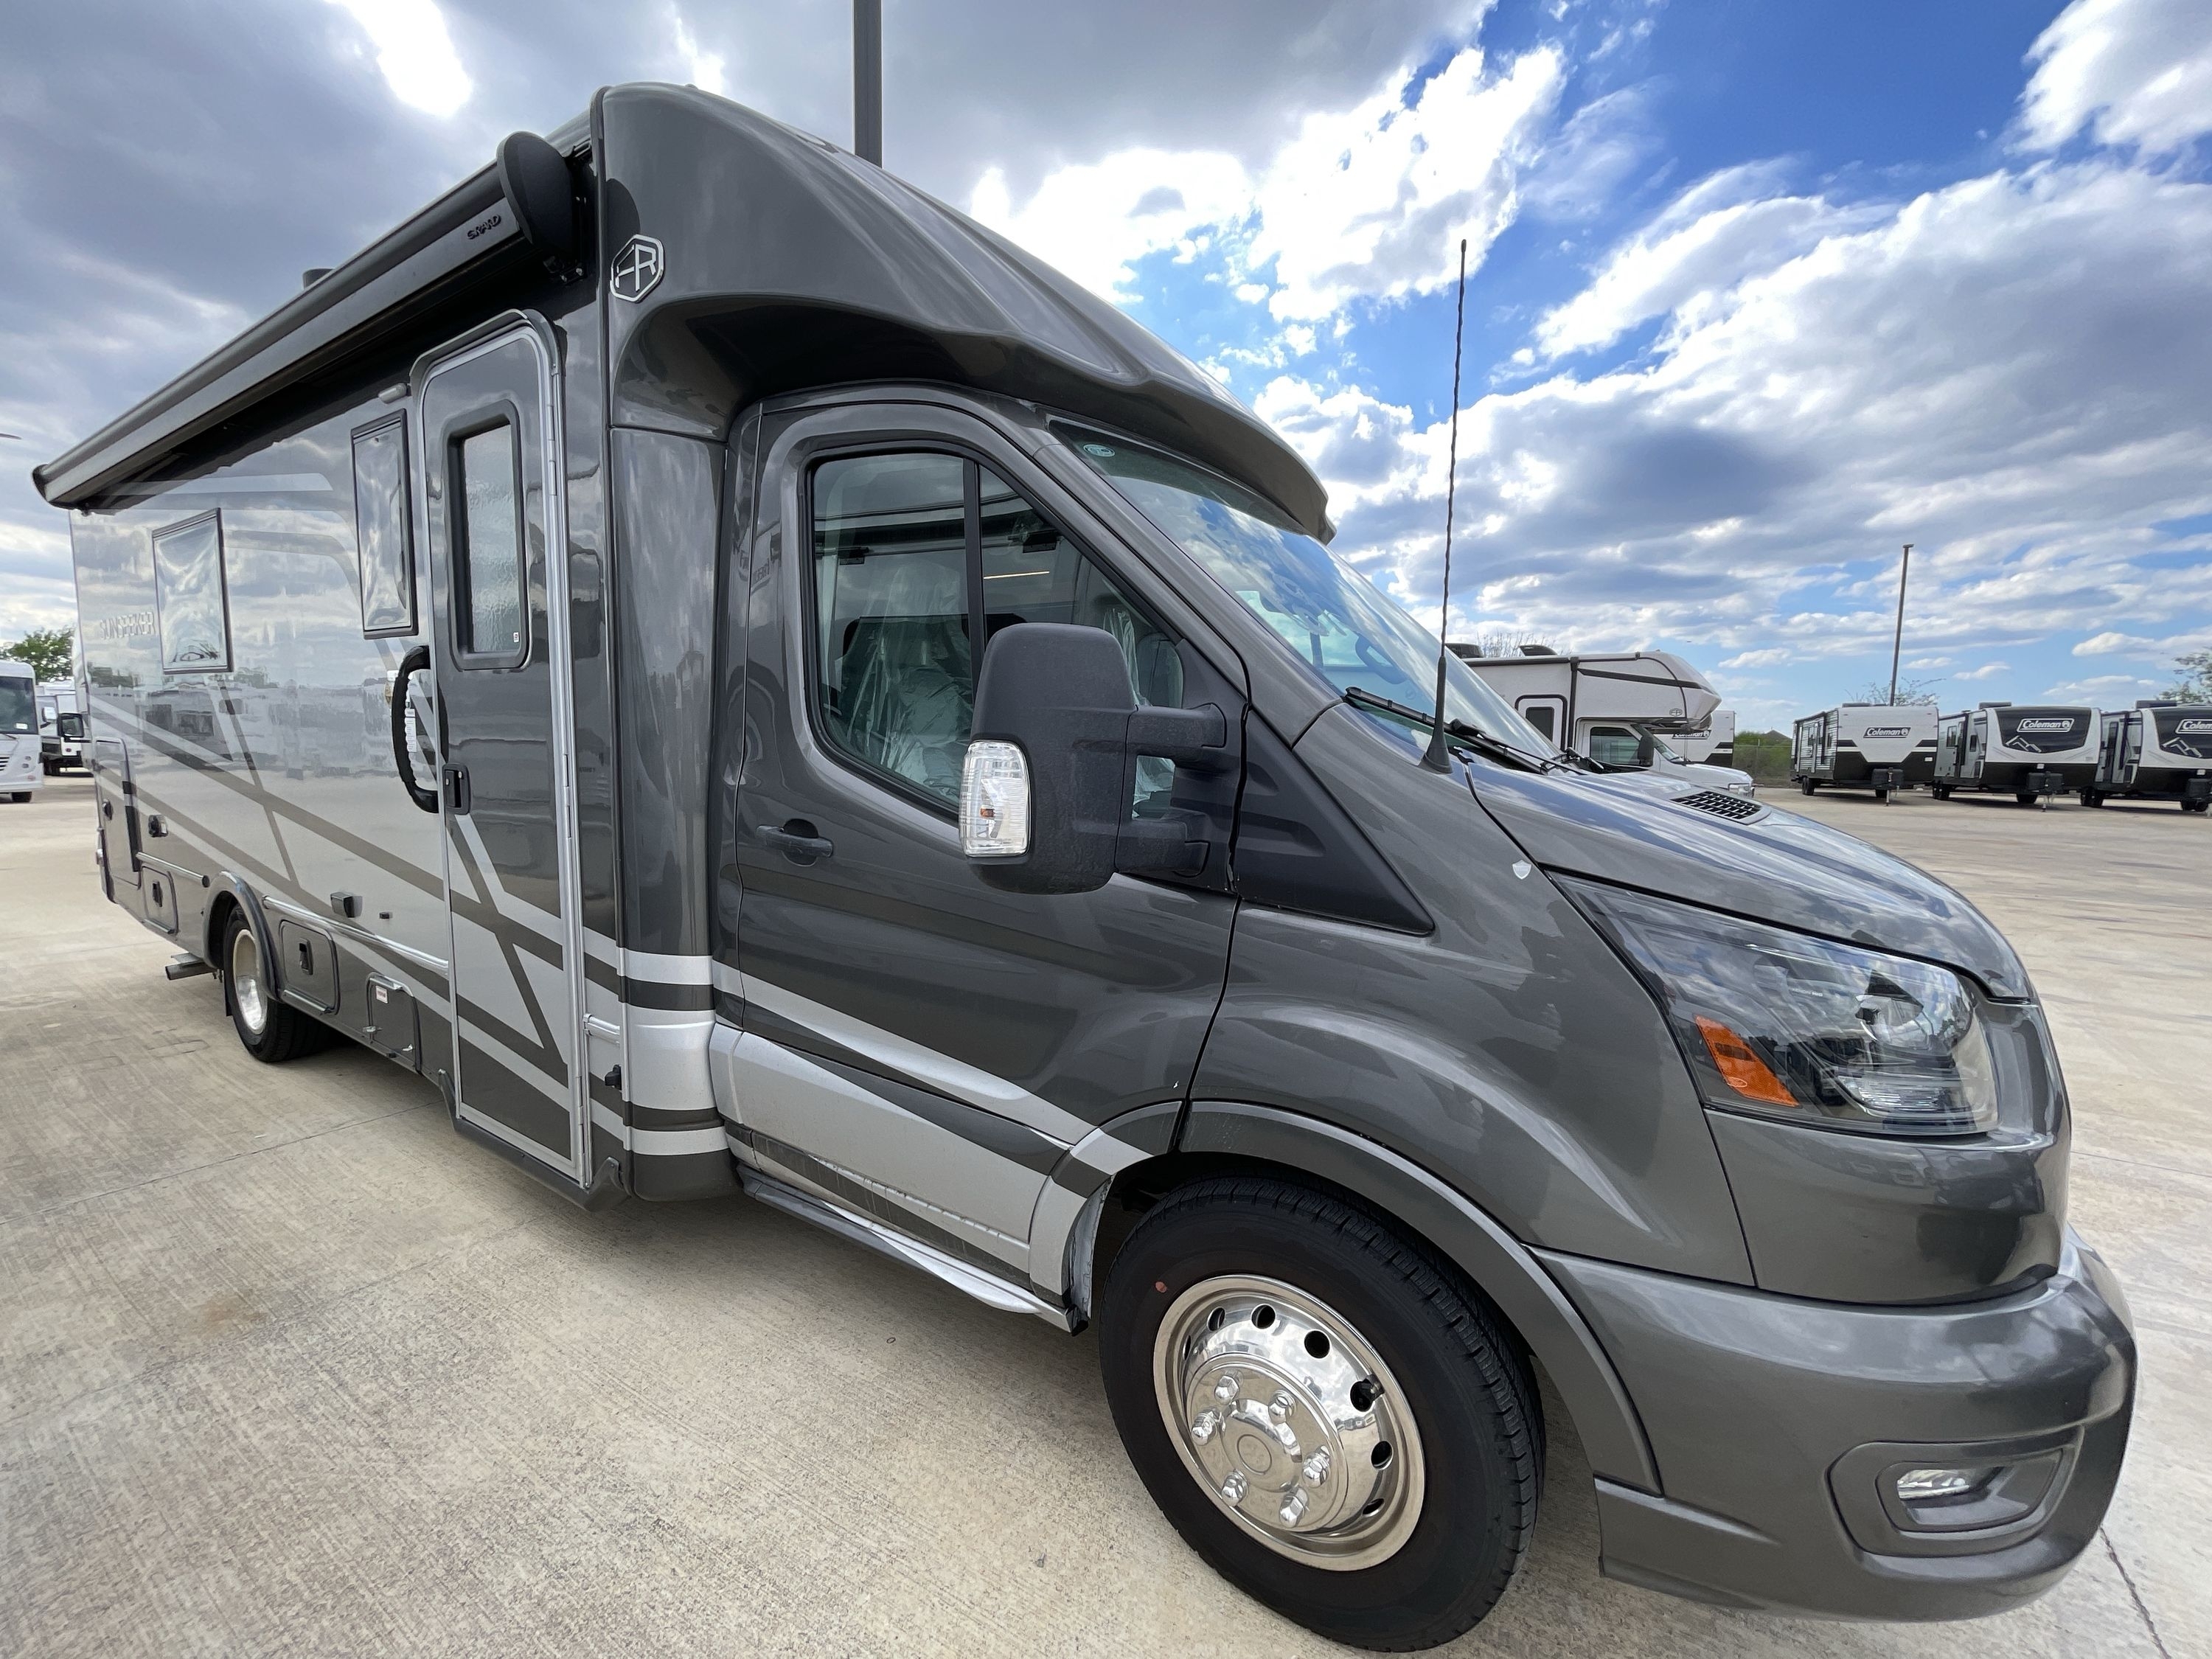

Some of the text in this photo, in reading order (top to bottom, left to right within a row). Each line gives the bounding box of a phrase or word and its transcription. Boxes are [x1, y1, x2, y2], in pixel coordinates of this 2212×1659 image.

[100, 611, 156, 640] SUNSEEKER
[2023, 720, 2061, 728] Coleman
[1867, 728, 1900, 736] Coleman
